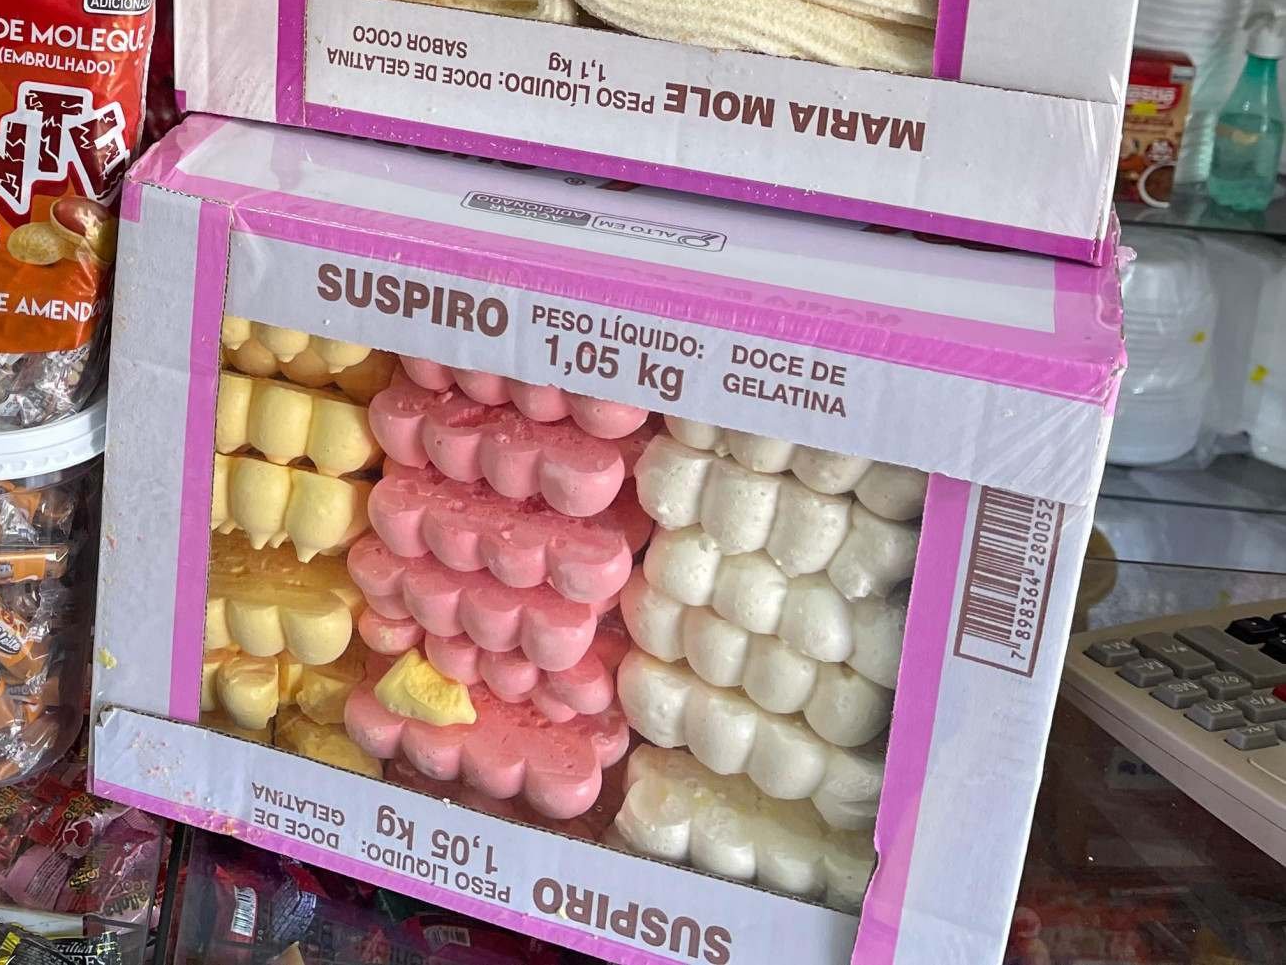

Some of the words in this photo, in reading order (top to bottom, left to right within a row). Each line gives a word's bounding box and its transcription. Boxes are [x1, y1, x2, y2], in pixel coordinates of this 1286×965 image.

[31, 24, 146, 53] MOLEQUE
[354, 26, 403, 49] COCO
[409, 35, 468, 58] SABOR
[327, 47, 409, 78] GELATINA
[414, 62, 437, 82] DE
[442, 67, 493, 90] DOCE
[550, 50, 575, 75] kg
[582, 58, 606, 82] 1,1
[499, 70, 591, 109] LÍQUIDO:
[597, 87, 655, 114] PESO
[665, 82, 776, 126] MOLE
[789, 99, 926, 151] MARIA
[475, 194, 586, 220] ADICIONADO
[599, 219, 626, 231] EM
[630, 225, 676, 239] ALTO
[317, 263, 509, 338] SUSPIRO
[531, 304, 595, 335] PESO
[601, 309, 704, 359] LÍQUIDO:
[544, 338, 620, 381] 1,05
[636, 354, 685, 401] kg
[731, 345, 804, 379] DOCE
[810, 359, 846, 386] DE
[722, 373, 847, 418] GELATINA
[1028, 498, 1055, 567] 280052
[1015, 572, 1042, 642] 898364
[251, 781, 346, 827] GELATINA
[254, 806, 280, 830] DE
[295, 821, 340, 850] DOCE
[376, 804, 415, 846] kg
[360, 838, 460, 886] LÍQUIDO:
[431, 827, 499, 876] 1,05
[464, 874, 512, 905] PESO
[533, 875, 733, 965] SUSPIRO
